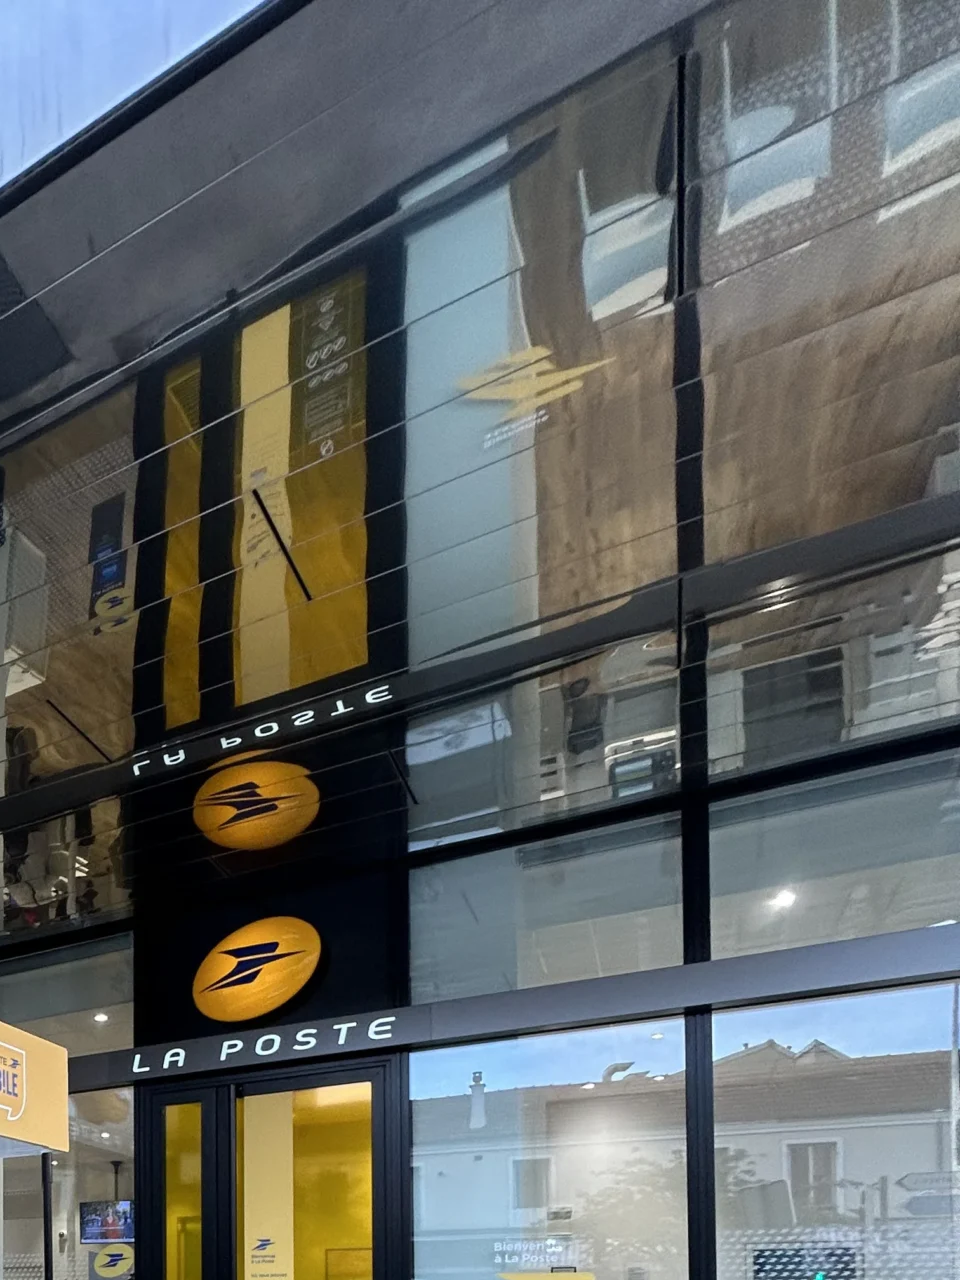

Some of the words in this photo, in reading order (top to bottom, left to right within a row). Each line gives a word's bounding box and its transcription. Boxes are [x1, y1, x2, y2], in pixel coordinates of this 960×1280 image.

[132, 1047, 186, 1073] LA
[219, 1016, 396, 1061] POSTE
[493, 1239, 560, 1252] Bienven
[494, 1253, 502, 1263] à
[504, 1254, 519, 1263] La
[522, 1253, 558, 1263] Poste
